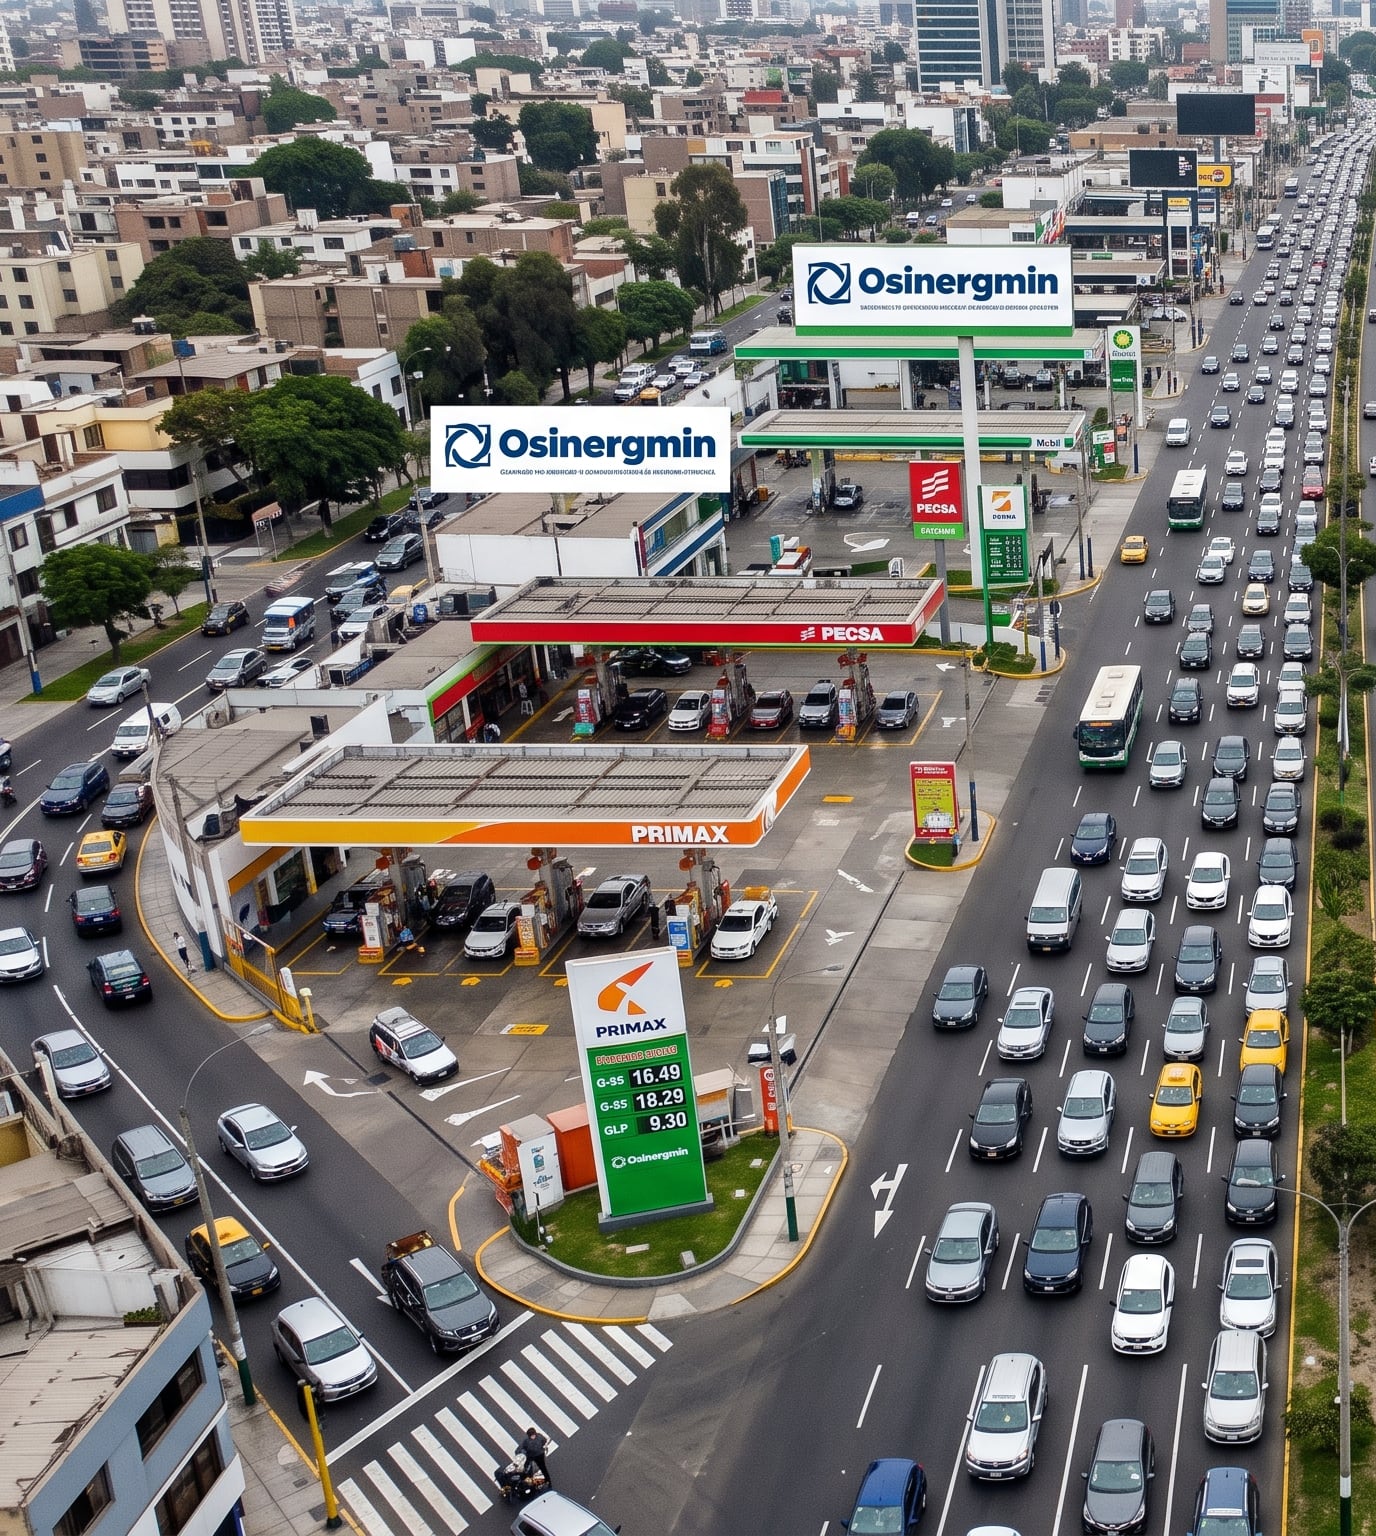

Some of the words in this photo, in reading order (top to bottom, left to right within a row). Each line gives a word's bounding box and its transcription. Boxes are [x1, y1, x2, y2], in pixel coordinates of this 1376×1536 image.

[858, 265, 1059, 301] Osinergmin
[499, 427, 717, 465] Osinergmin
[916, 503, 957, 514] PECSA
[821, 626, 884, 641] PECSA
[631, 825, 729, 844] PRIMAX
[596, 1018, 667, 1038] PRIMAX
[632, 1063, 681, 1085] 16.49
[635, 1087, 684, 1109] 18.29
[604, 1123, 629, 1136] GLP
[649, 1111, 687, 1131] 9.30
